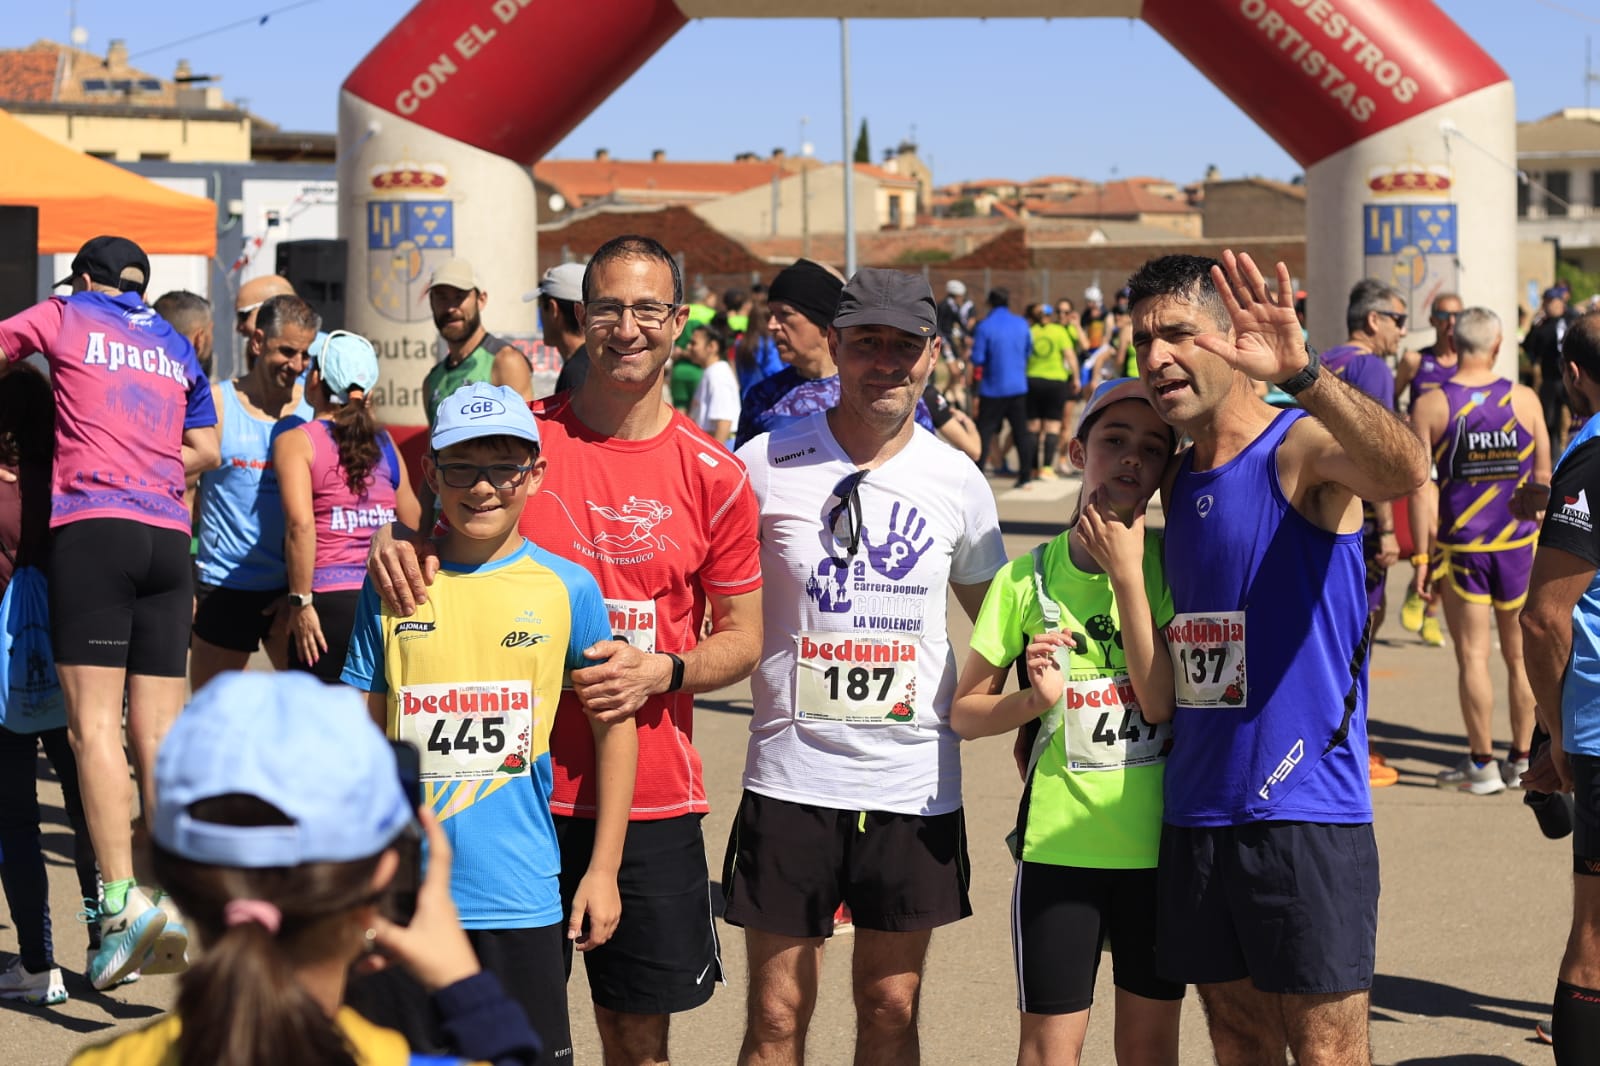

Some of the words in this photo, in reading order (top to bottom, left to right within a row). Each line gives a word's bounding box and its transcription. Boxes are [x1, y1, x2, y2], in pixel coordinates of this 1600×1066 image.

[395, 53, 458, 115] CON
[453, 24, 497, 60] EL
[461, 401, 493, 415] CGB
[1468, 430, 1518, 450] PRIM
[774, 449, 805, 464] luanvi
[581, 546, 595, 558] KM
[854, 582, 892, 593] carrera
[893, 584, 928, 595] popular
[854, 616, 866, 628] LA
[869, 617, 921, 631] VIOLENCIA
[801, 637, 915, 662] bedunia
[1180, 648, 1227, 684] 137
[824, 666, 895, 701] 187
[403, 687, 529, 716] bedunia
[427, 717, 506, 755] 445
